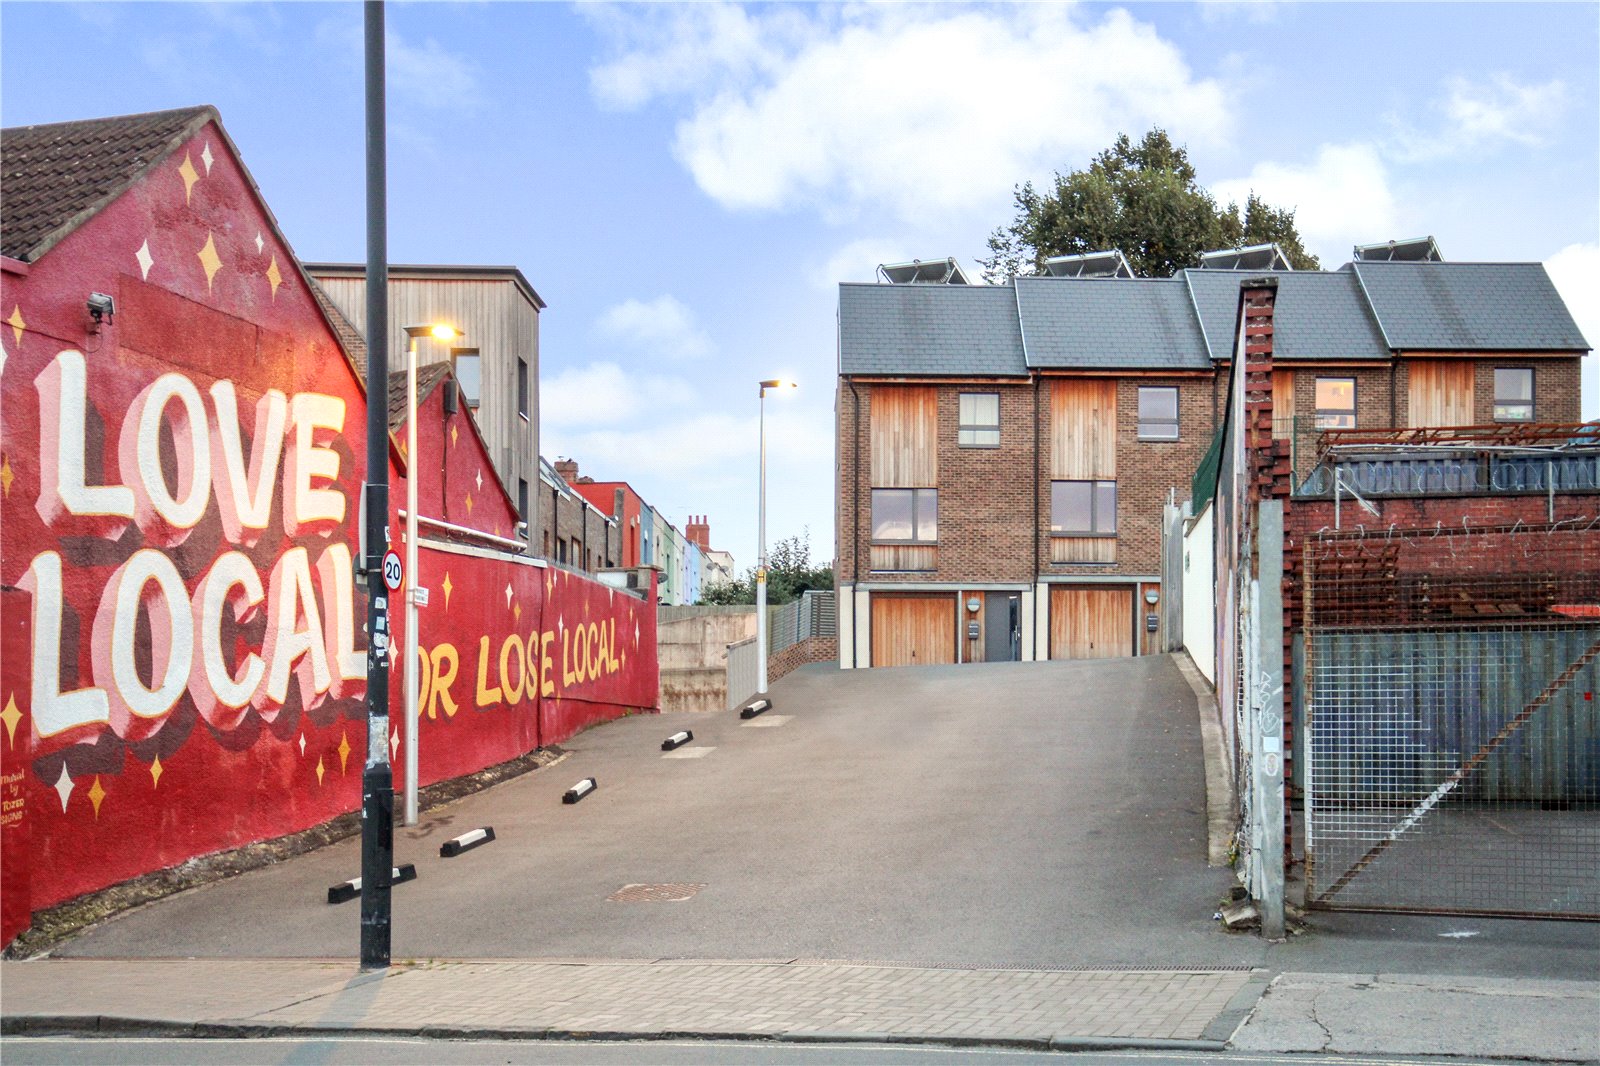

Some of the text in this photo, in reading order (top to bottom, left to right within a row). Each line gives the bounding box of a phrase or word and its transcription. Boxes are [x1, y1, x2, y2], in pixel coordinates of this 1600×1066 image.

[55, 350, 347, 529] LOVE
[385, 561, 401, 580] 20
[29, 543, 367, 738] LOCAL
[476, 630, 555, 706] LOSE
[563, 617, 619, 688] LOCAL
